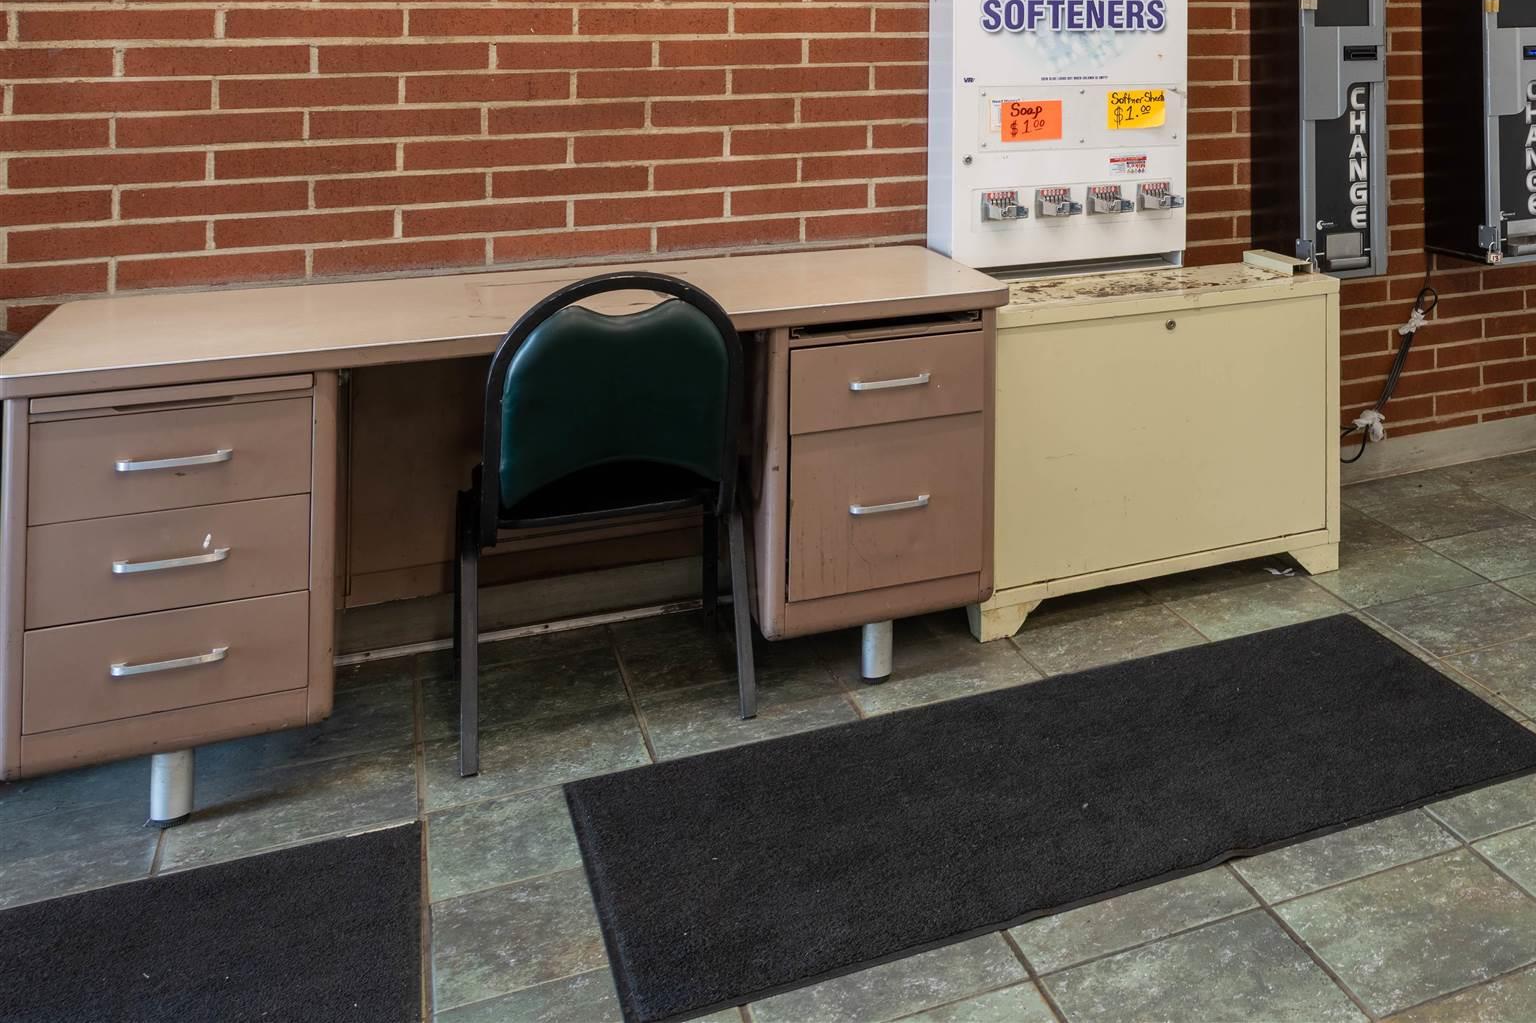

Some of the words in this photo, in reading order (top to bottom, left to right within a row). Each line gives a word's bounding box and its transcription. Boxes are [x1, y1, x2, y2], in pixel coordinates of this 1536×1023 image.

[982, 0, 1165, 31] SOFTENERS
[1010, 102, 1043, 120] Soap
[1349, 87, 1367, 229] CHANGE
